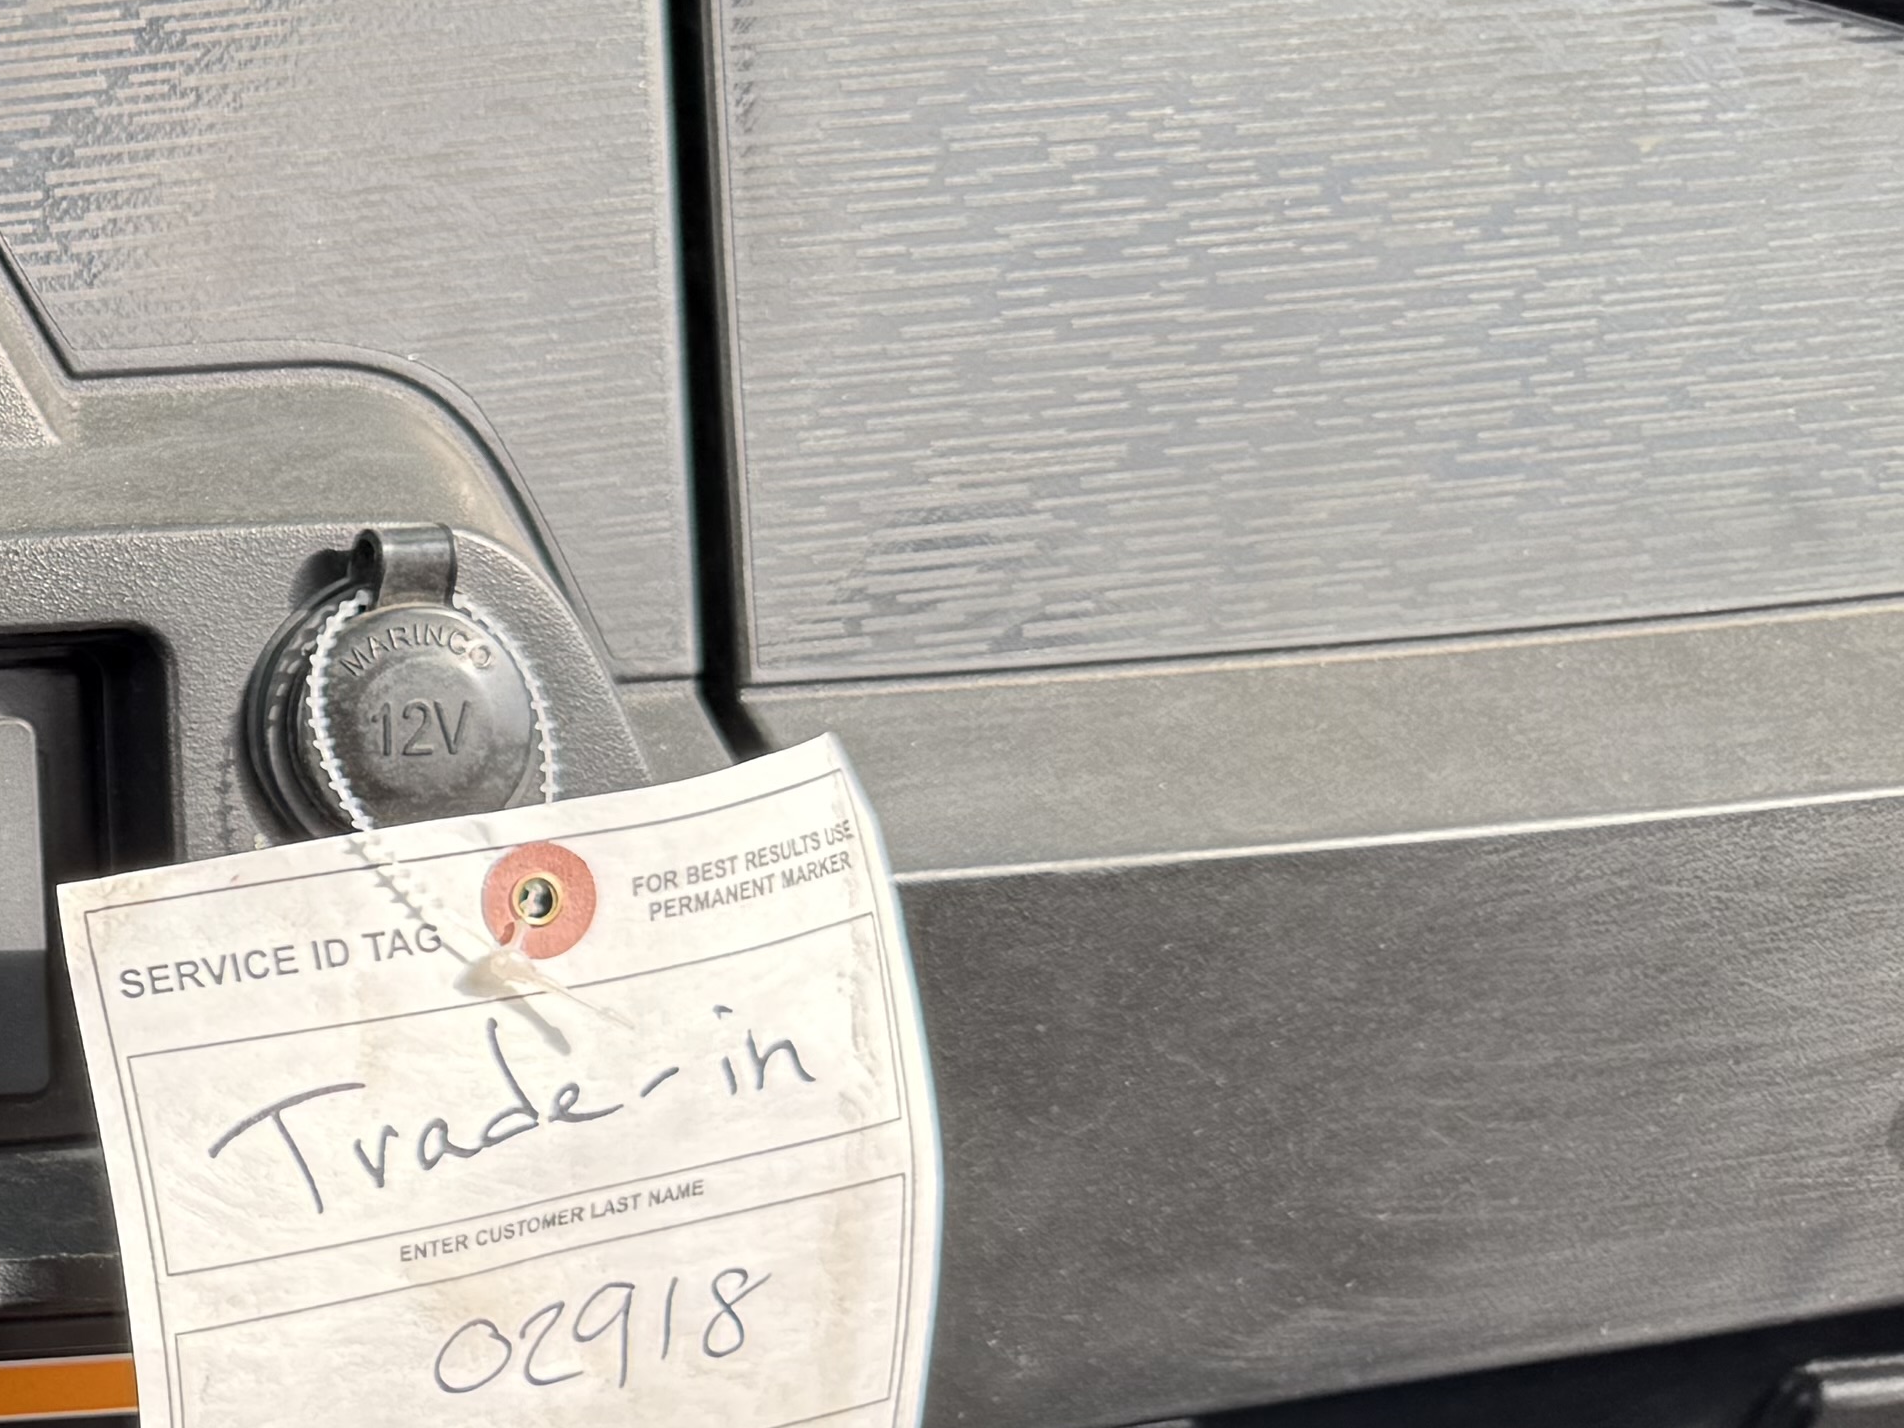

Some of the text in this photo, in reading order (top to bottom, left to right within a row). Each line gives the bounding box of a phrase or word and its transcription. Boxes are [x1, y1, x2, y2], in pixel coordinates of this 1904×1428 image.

[340, 624, 491, 677] MARINCO
[371, 698, 471, 757] 12V
[631, 823, 855, 897] FOR BEST RESULTS USE
[648, 853, 853, 922] PERMANENT MARKER
[119, 925, 445, 999] SERVICE ID TAG
[208, 1005, 817, 1214] Trade-in
[399, 1179, 705, 1263] ENTER CUSTOMER LAST NAME
[434, 1266, 772, 1396] 02918
